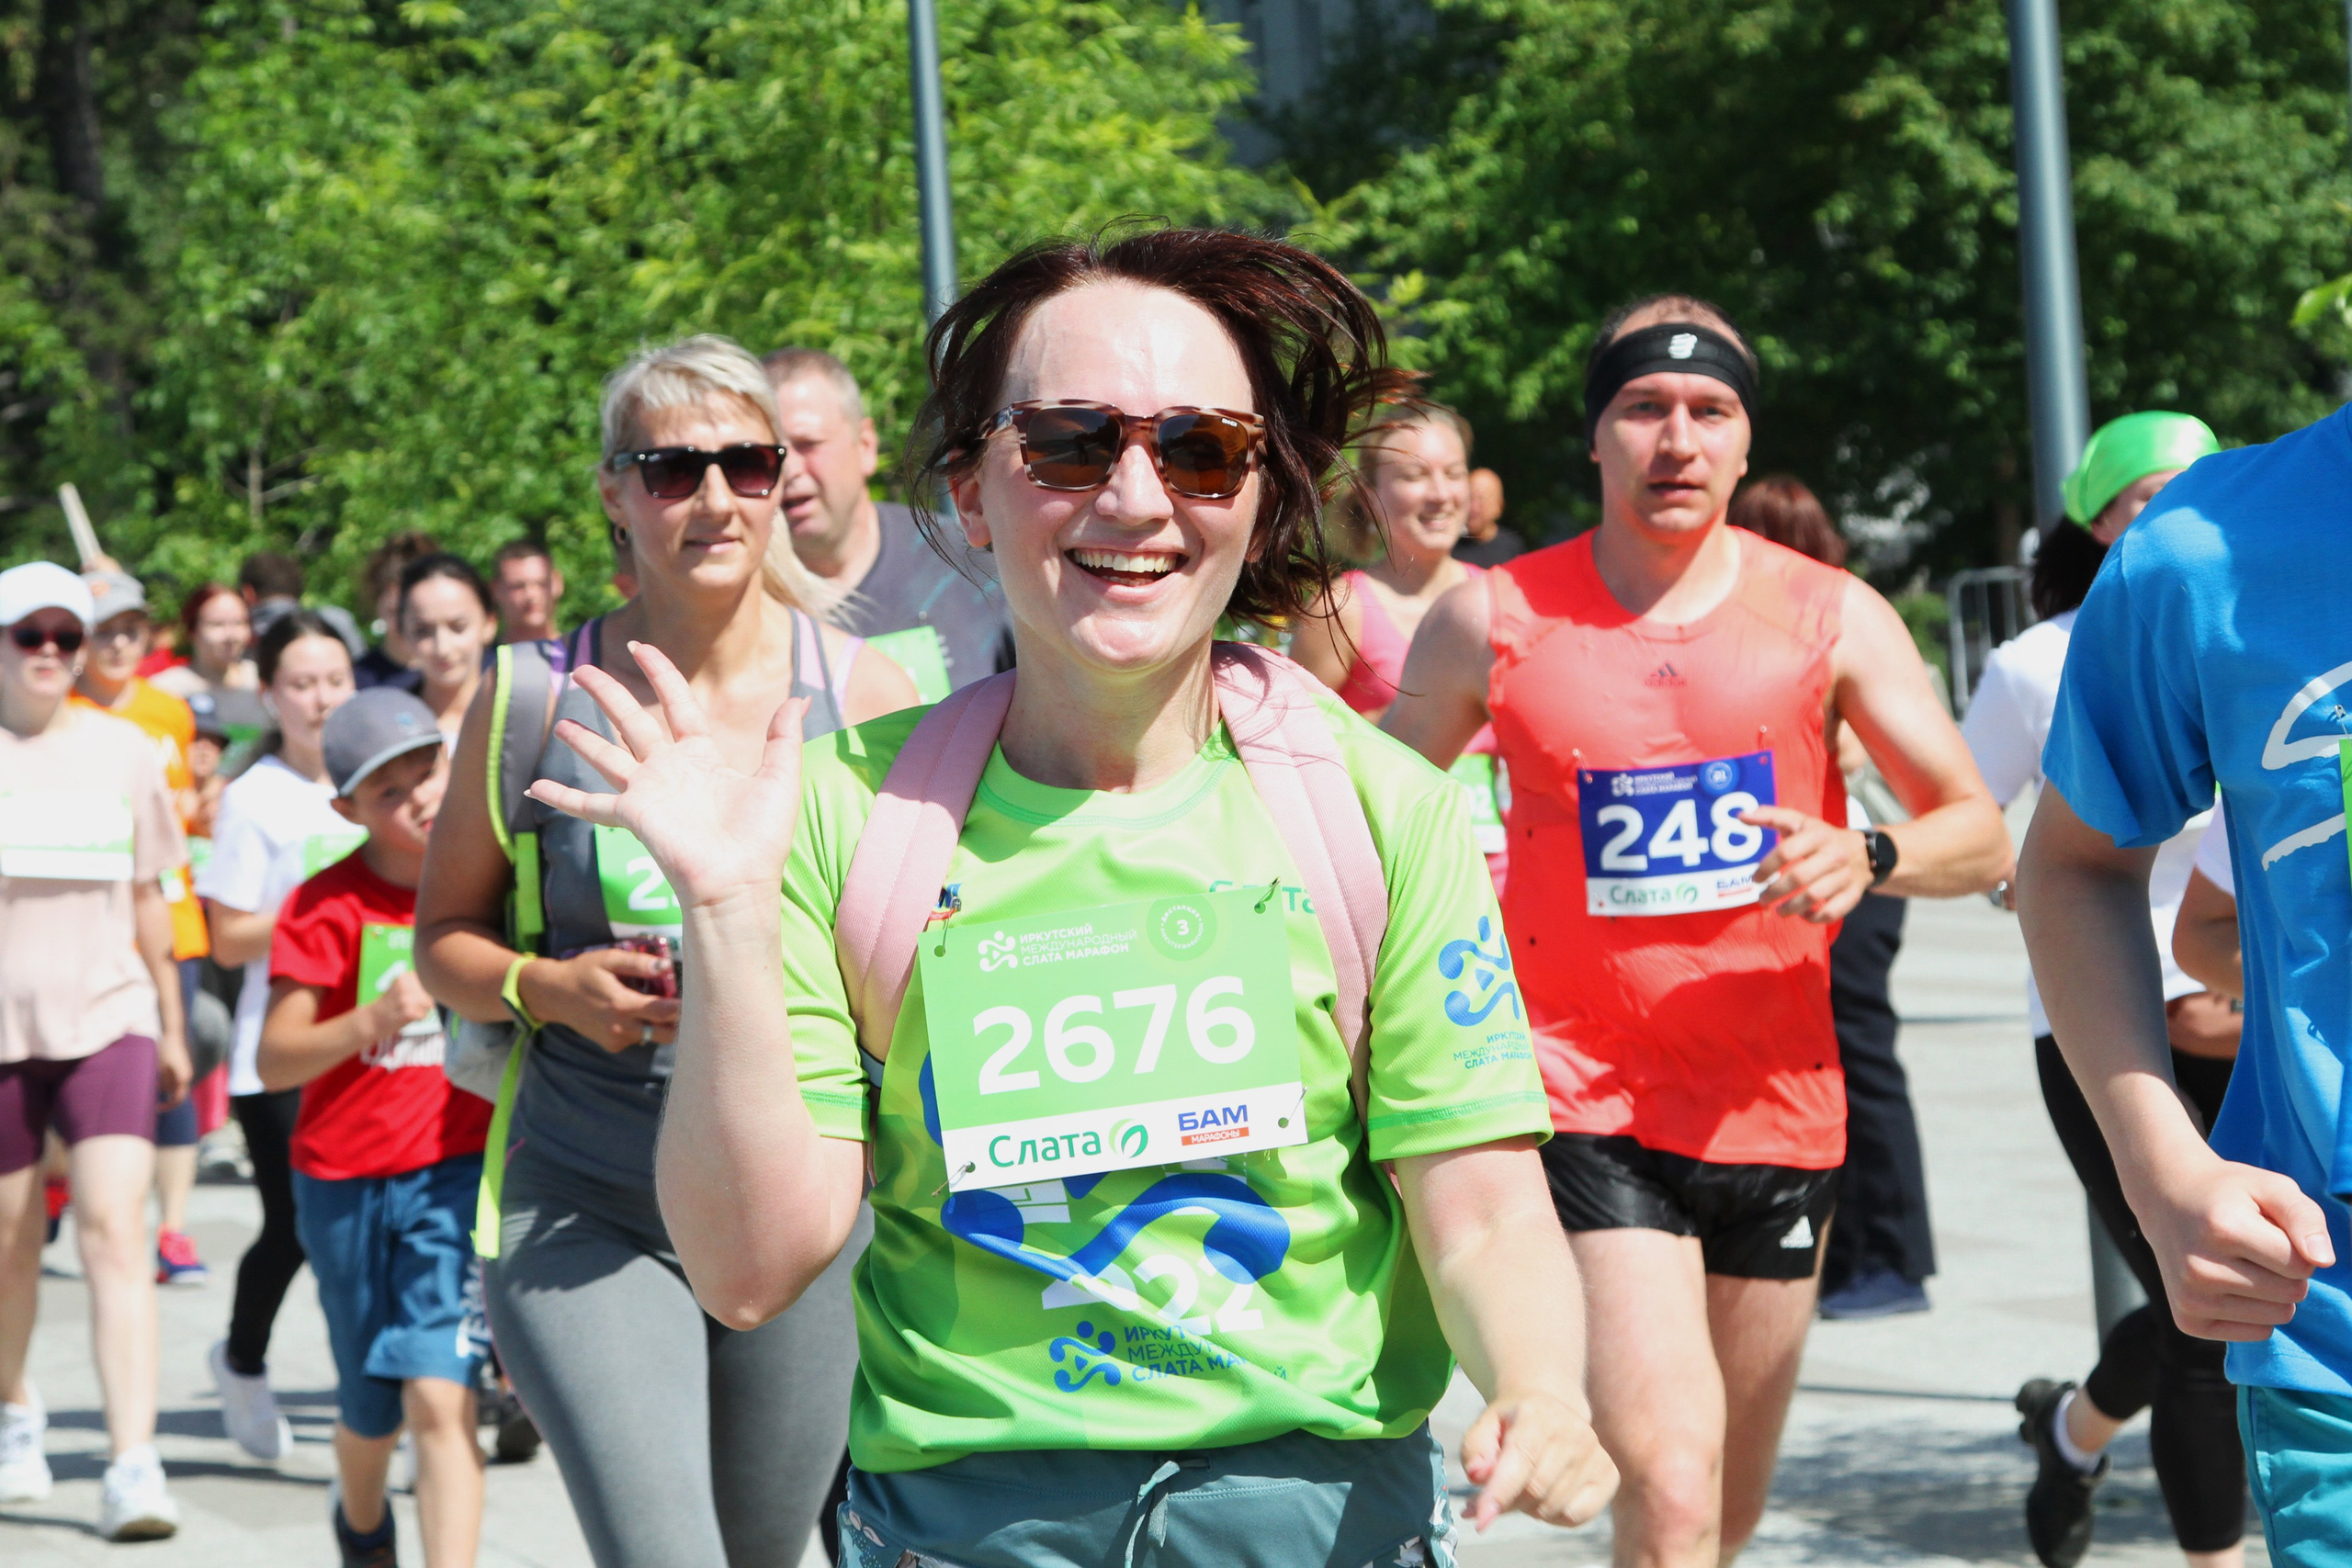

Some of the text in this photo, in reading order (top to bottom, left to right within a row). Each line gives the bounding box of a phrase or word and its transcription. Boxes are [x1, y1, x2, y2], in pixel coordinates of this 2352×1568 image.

[1596, 791, 1763, 871] 248
[1610, 884, 1672, 905] Слата
[1020, 922, 1093, 944] ИРКУТСКИЙ
[1176, 919, 1190, 936] 3
[1021, 928, 1137, 955] МЕЖДУНАРОДНЫЙ
[1023, 942, 1129, 966] СЛАТА МАРАФОН
[972, 975, 1256, 1096] 2676
[1464, 1055, 1498, 1069] СЛАТА
[1178, 1104, 1249, 1132] БАМ
[989, 1130, 1102, 1168] Слата
[1191, 1129, 1240, 1145] МАРАФОНЫ
[1132, 1351, 1248, 1382] СЛАТА МА
